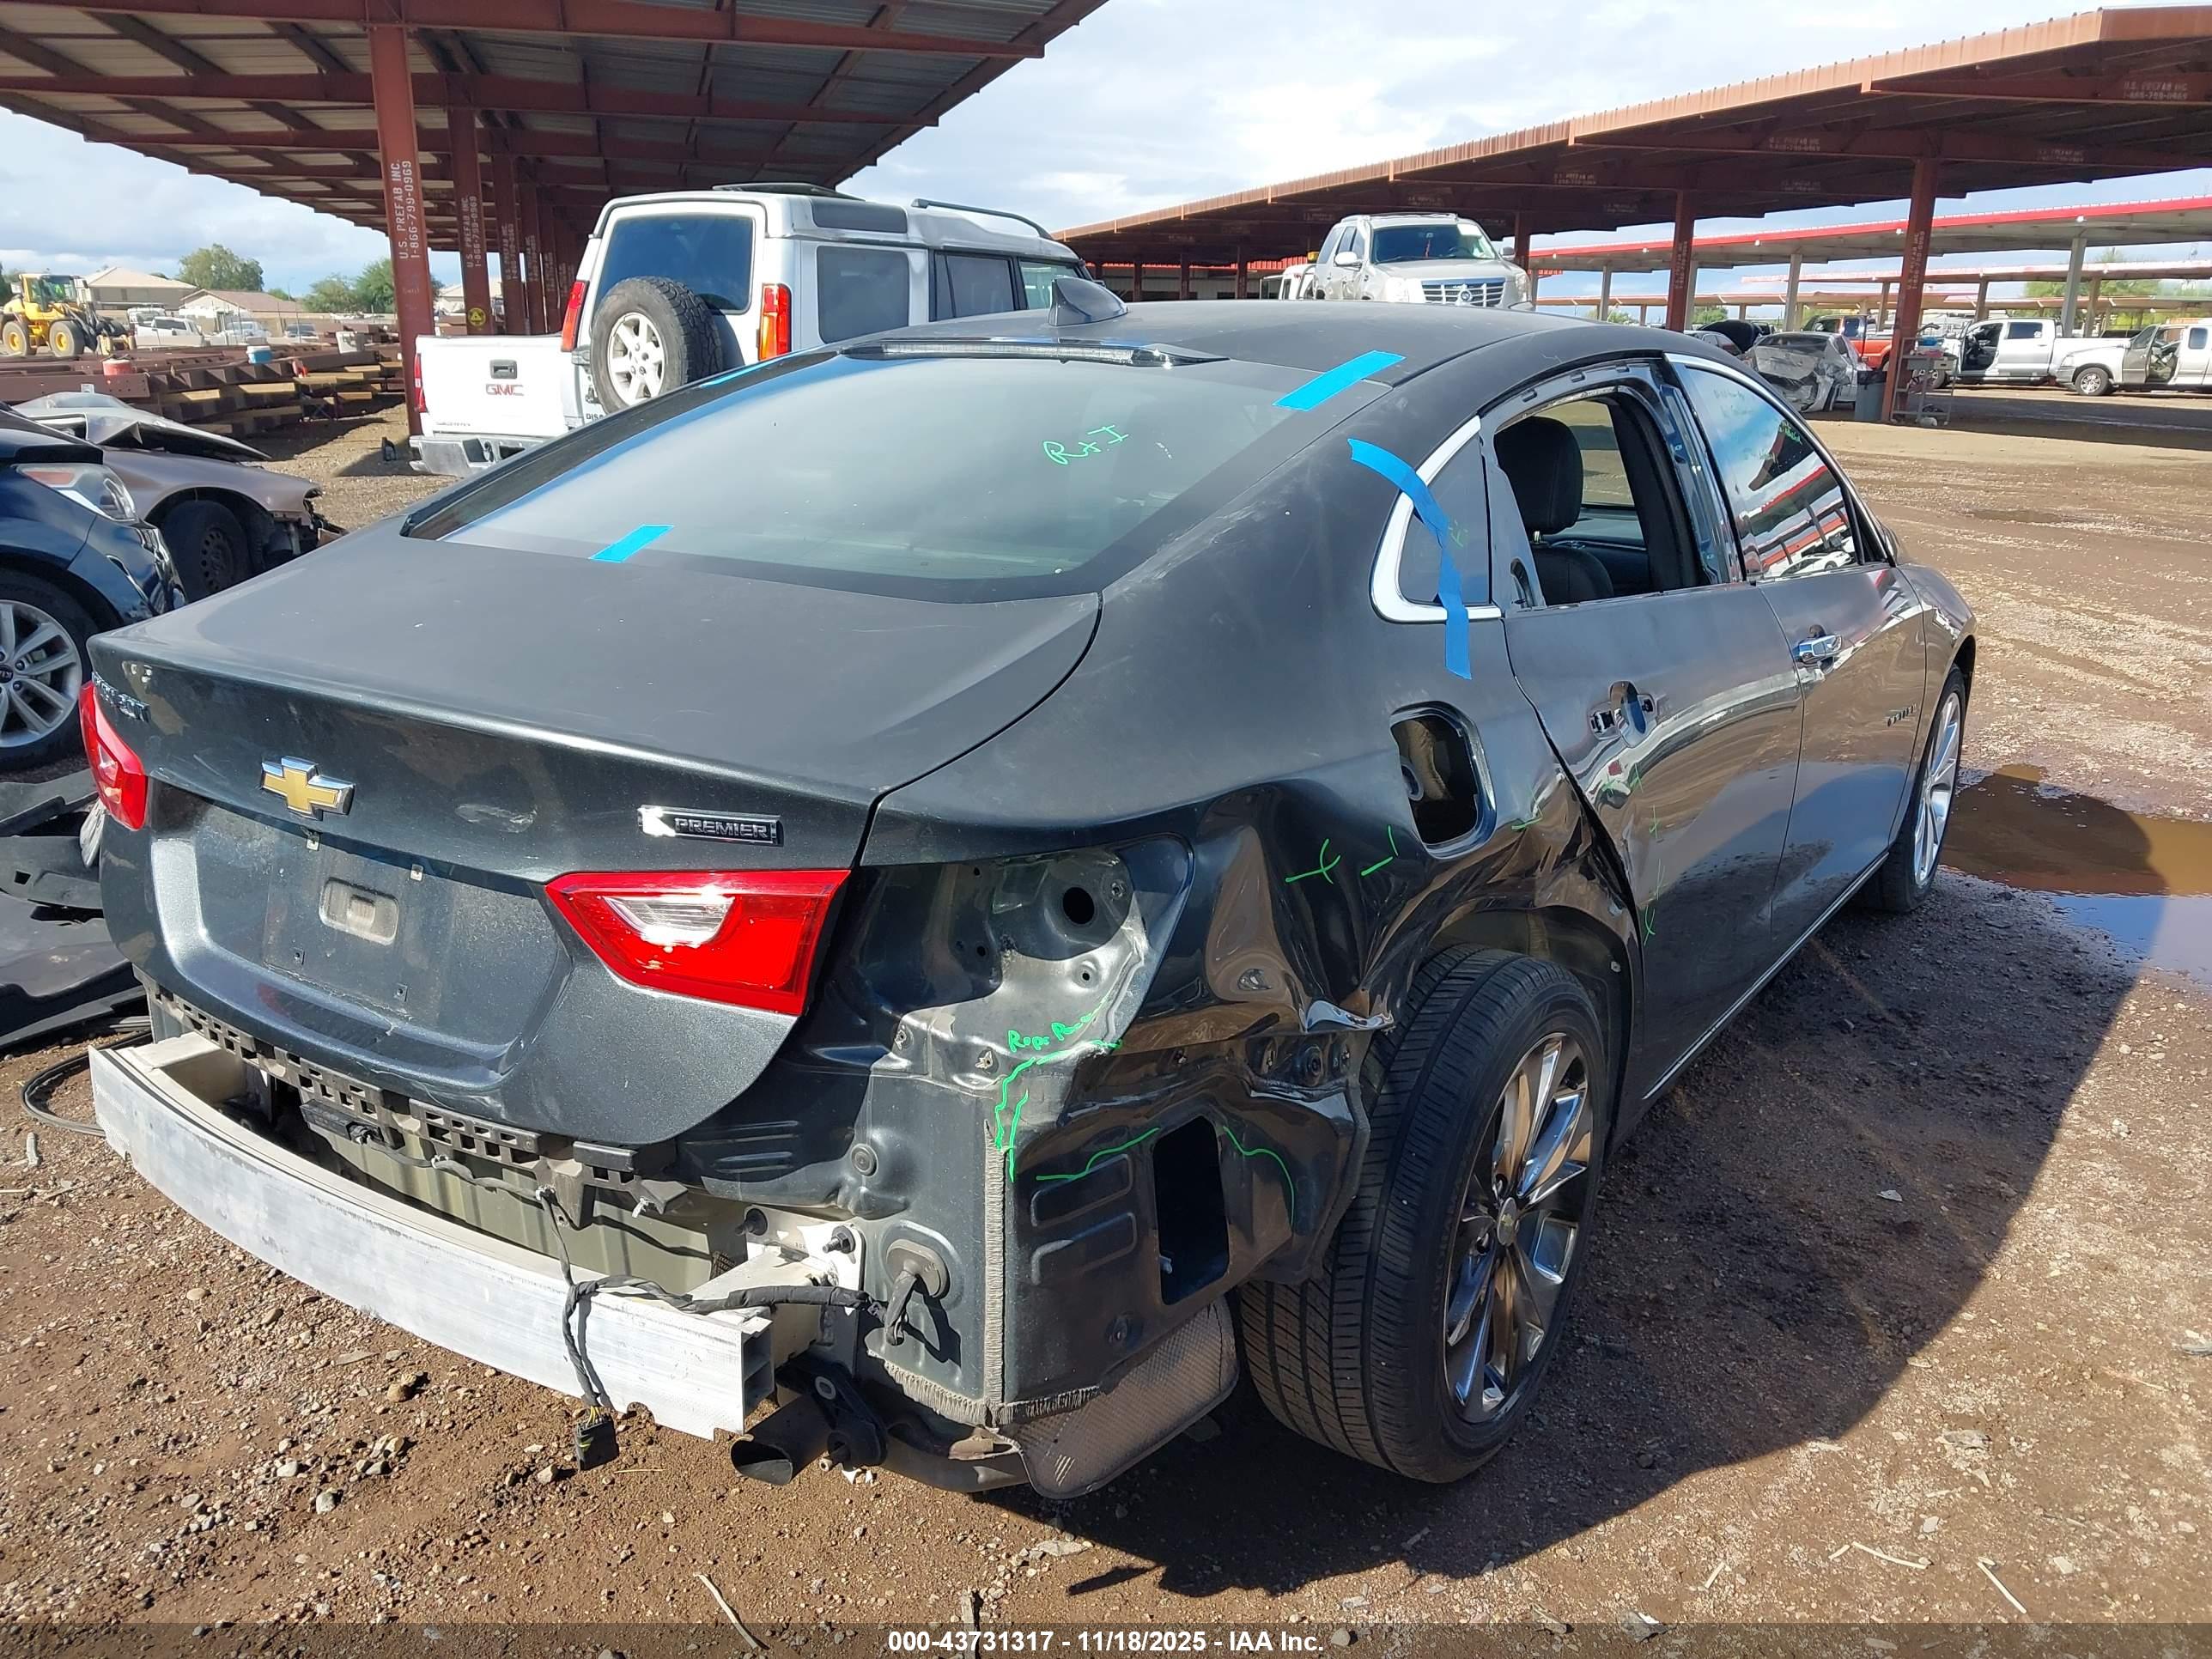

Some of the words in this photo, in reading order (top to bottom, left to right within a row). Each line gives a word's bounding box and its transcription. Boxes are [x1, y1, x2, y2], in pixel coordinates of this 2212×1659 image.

[391, 159, 402, 181] INC.
[392, 186, 407, 232] PREFAB
[402, 160, 420, 258] 1-866-799-0969
[398, 238, 410, 259] U.S.
[485, 383, 525, 397] GMC
[674, 817, 769, 839] PREMIER
